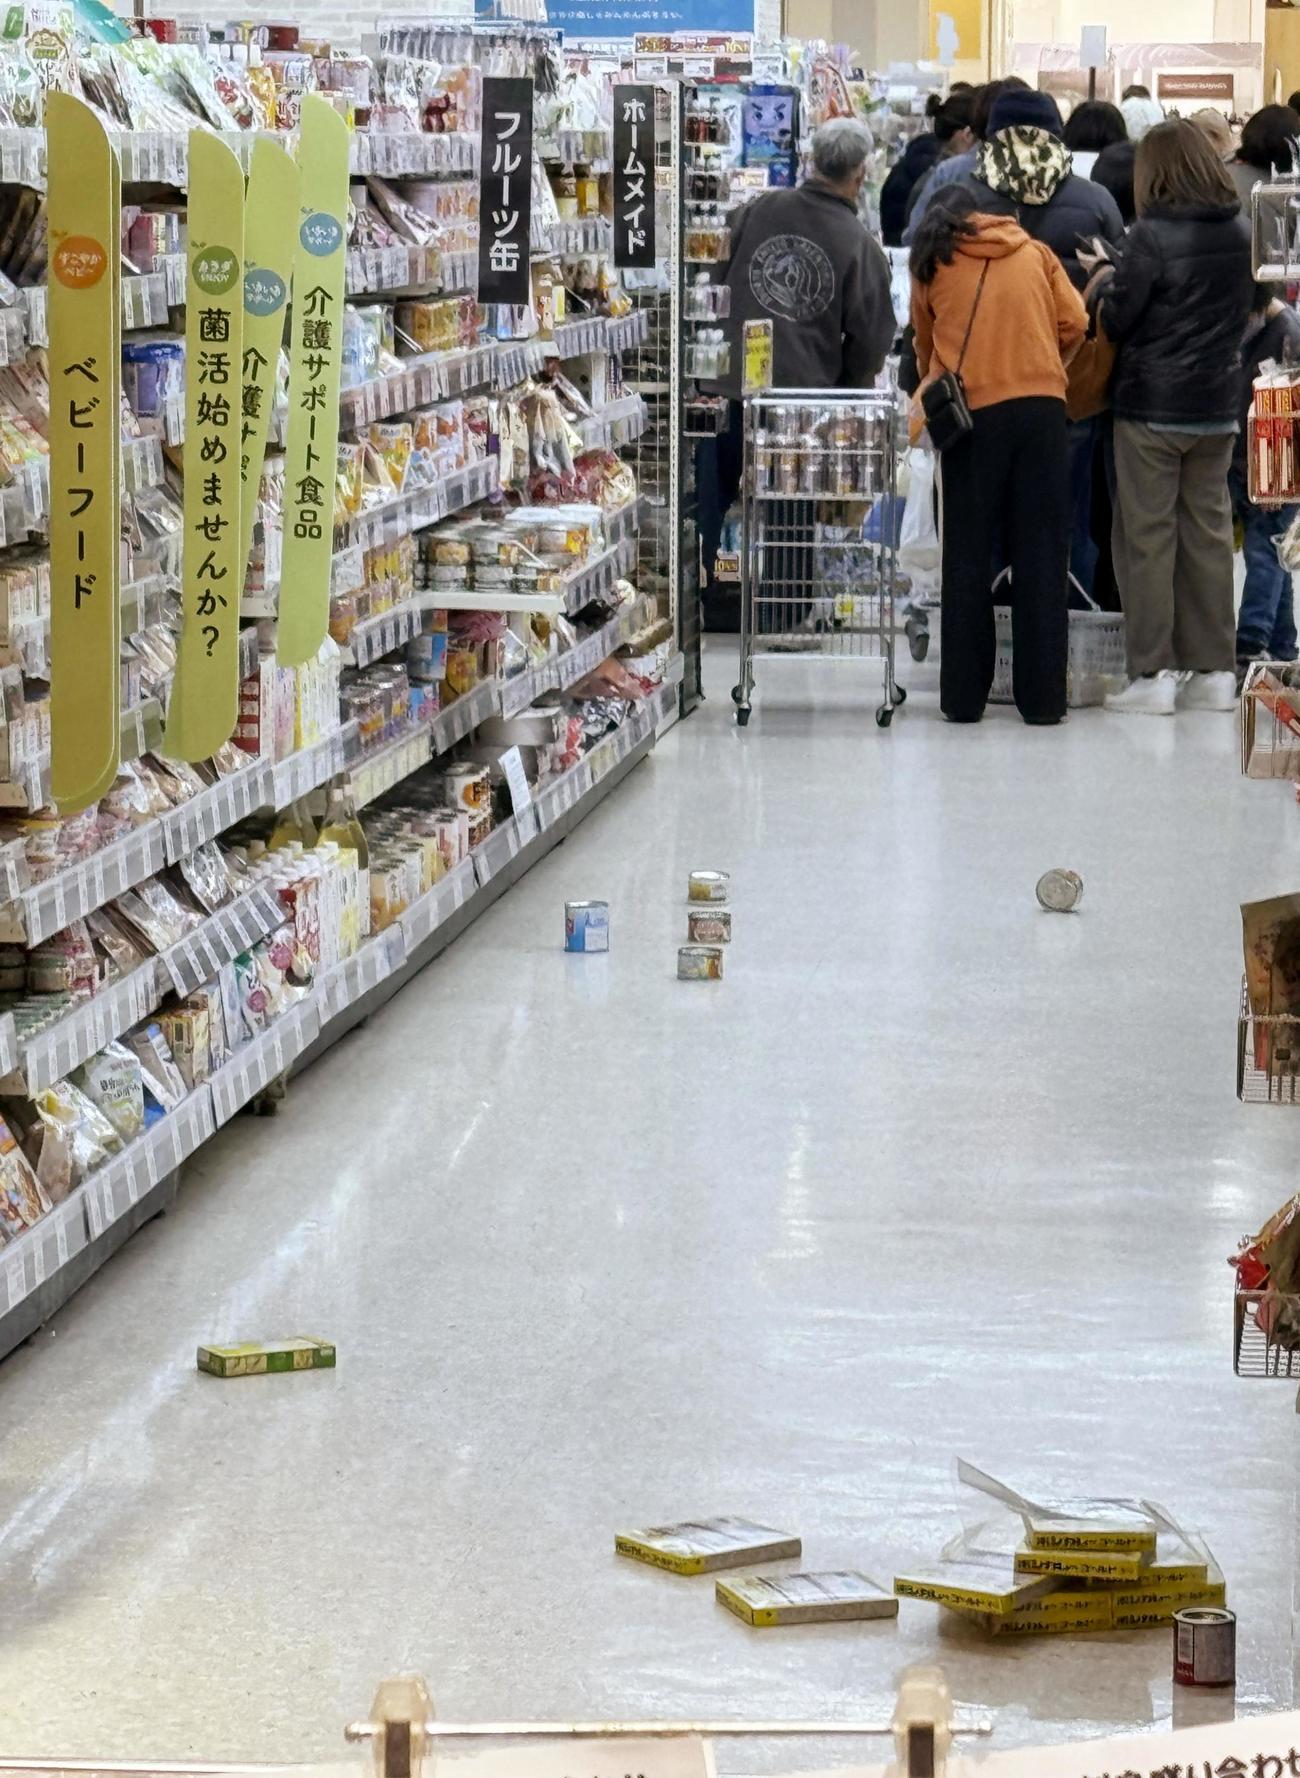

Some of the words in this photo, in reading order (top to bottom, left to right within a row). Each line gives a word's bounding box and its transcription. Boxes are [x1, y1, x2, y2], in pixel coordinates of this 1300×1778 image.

[489, 112, 522, 272] フルーツ缶
[623, 98, 646, 255] ホームメイド
[63, 356, 100, 609] ベビーフード
[294, 285, 333, 539] 介護サポート食品
